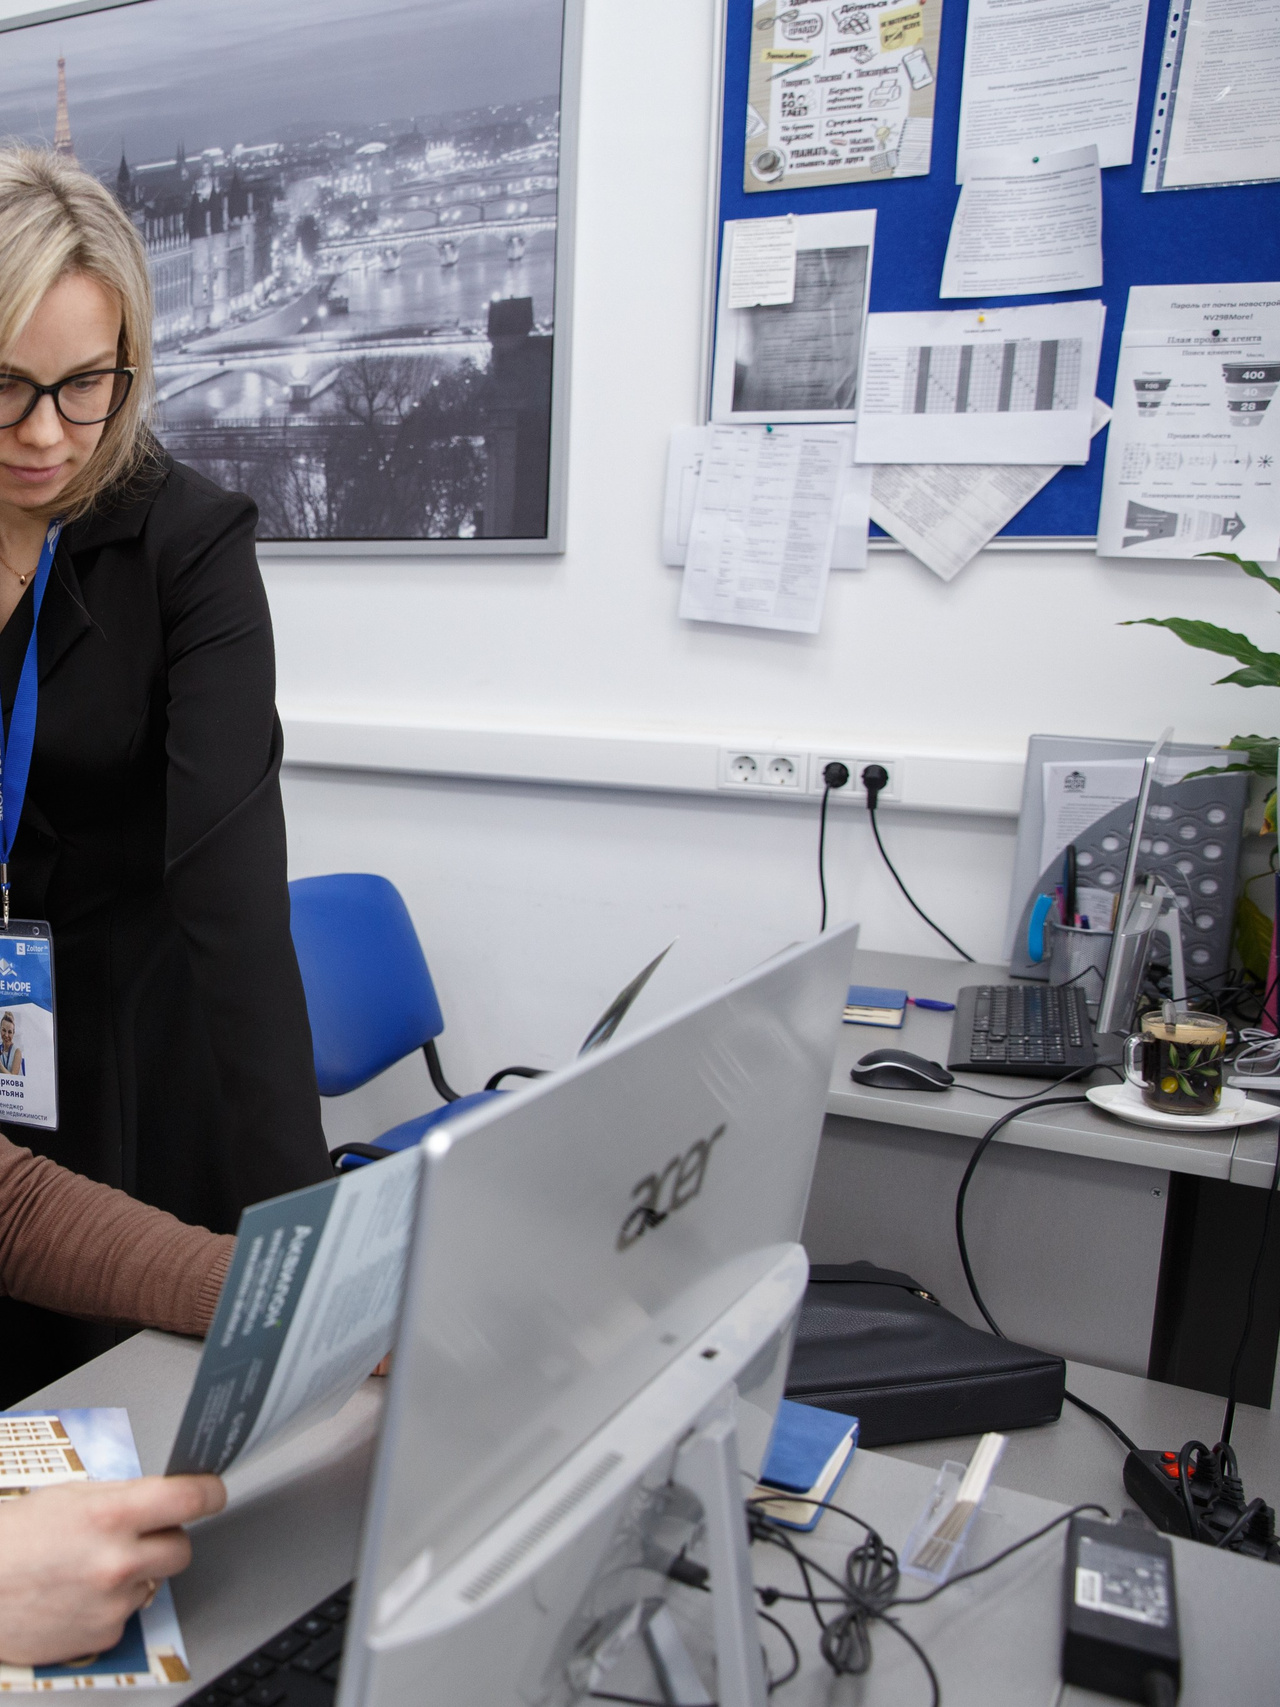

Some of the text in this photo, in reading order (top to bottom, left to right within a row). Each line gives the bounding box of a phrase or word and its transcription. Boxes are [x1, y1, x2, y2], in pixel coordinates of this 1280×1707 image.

[1242, 371, 1265, 380] 400
[1243, 388, 1258, 397] 40
[1240, 402, 1257, 411] 28
[6, 980, 31, 993] МОРЕ
[6, 1109, 48, 1121] недвижимости
[616, 1122, 728, 1252] acer
